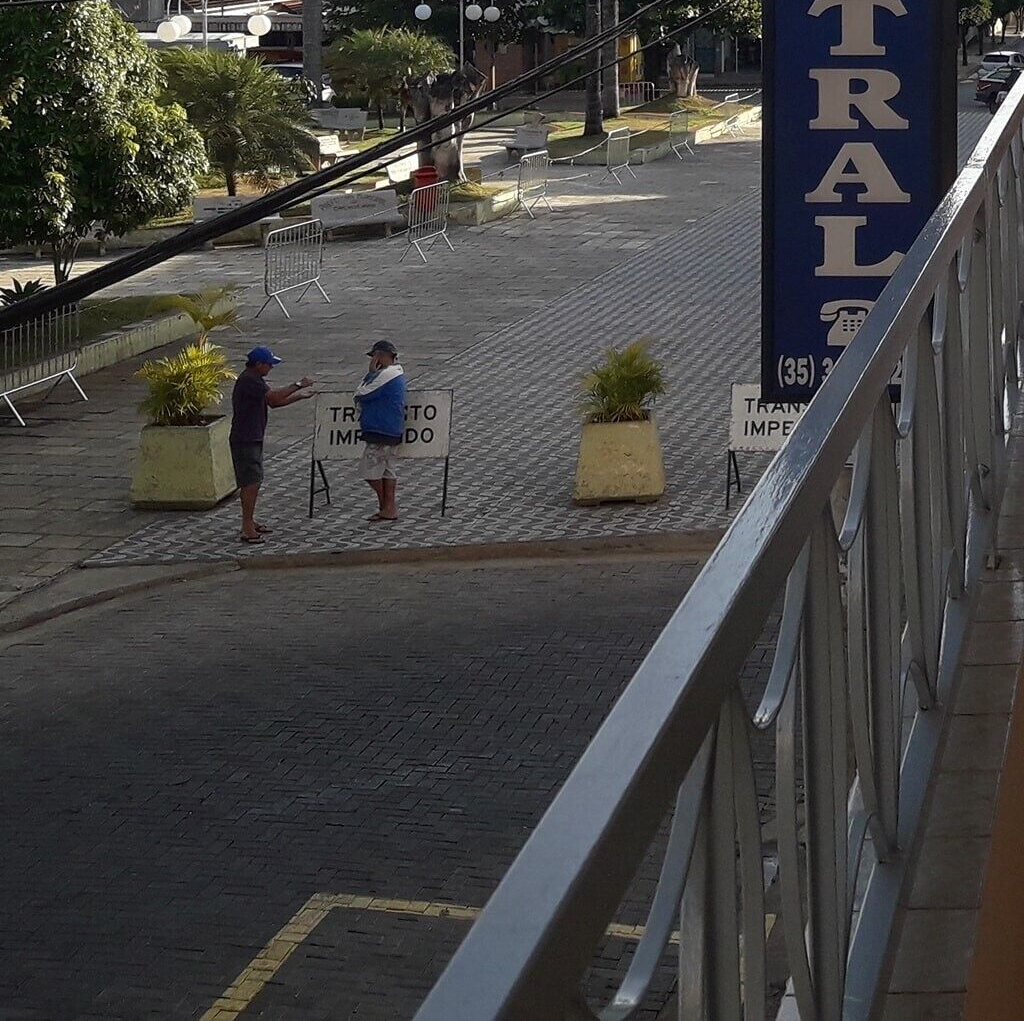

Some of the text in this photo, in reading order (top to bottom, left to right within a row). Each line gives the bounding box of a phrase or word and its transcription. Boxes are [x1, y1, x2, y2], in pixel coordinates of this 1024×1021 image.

[777, 354, 816, 387] (35)
[744, 397, 809, 414] TRAN
[329, 427, 434, 446] IMPDO
